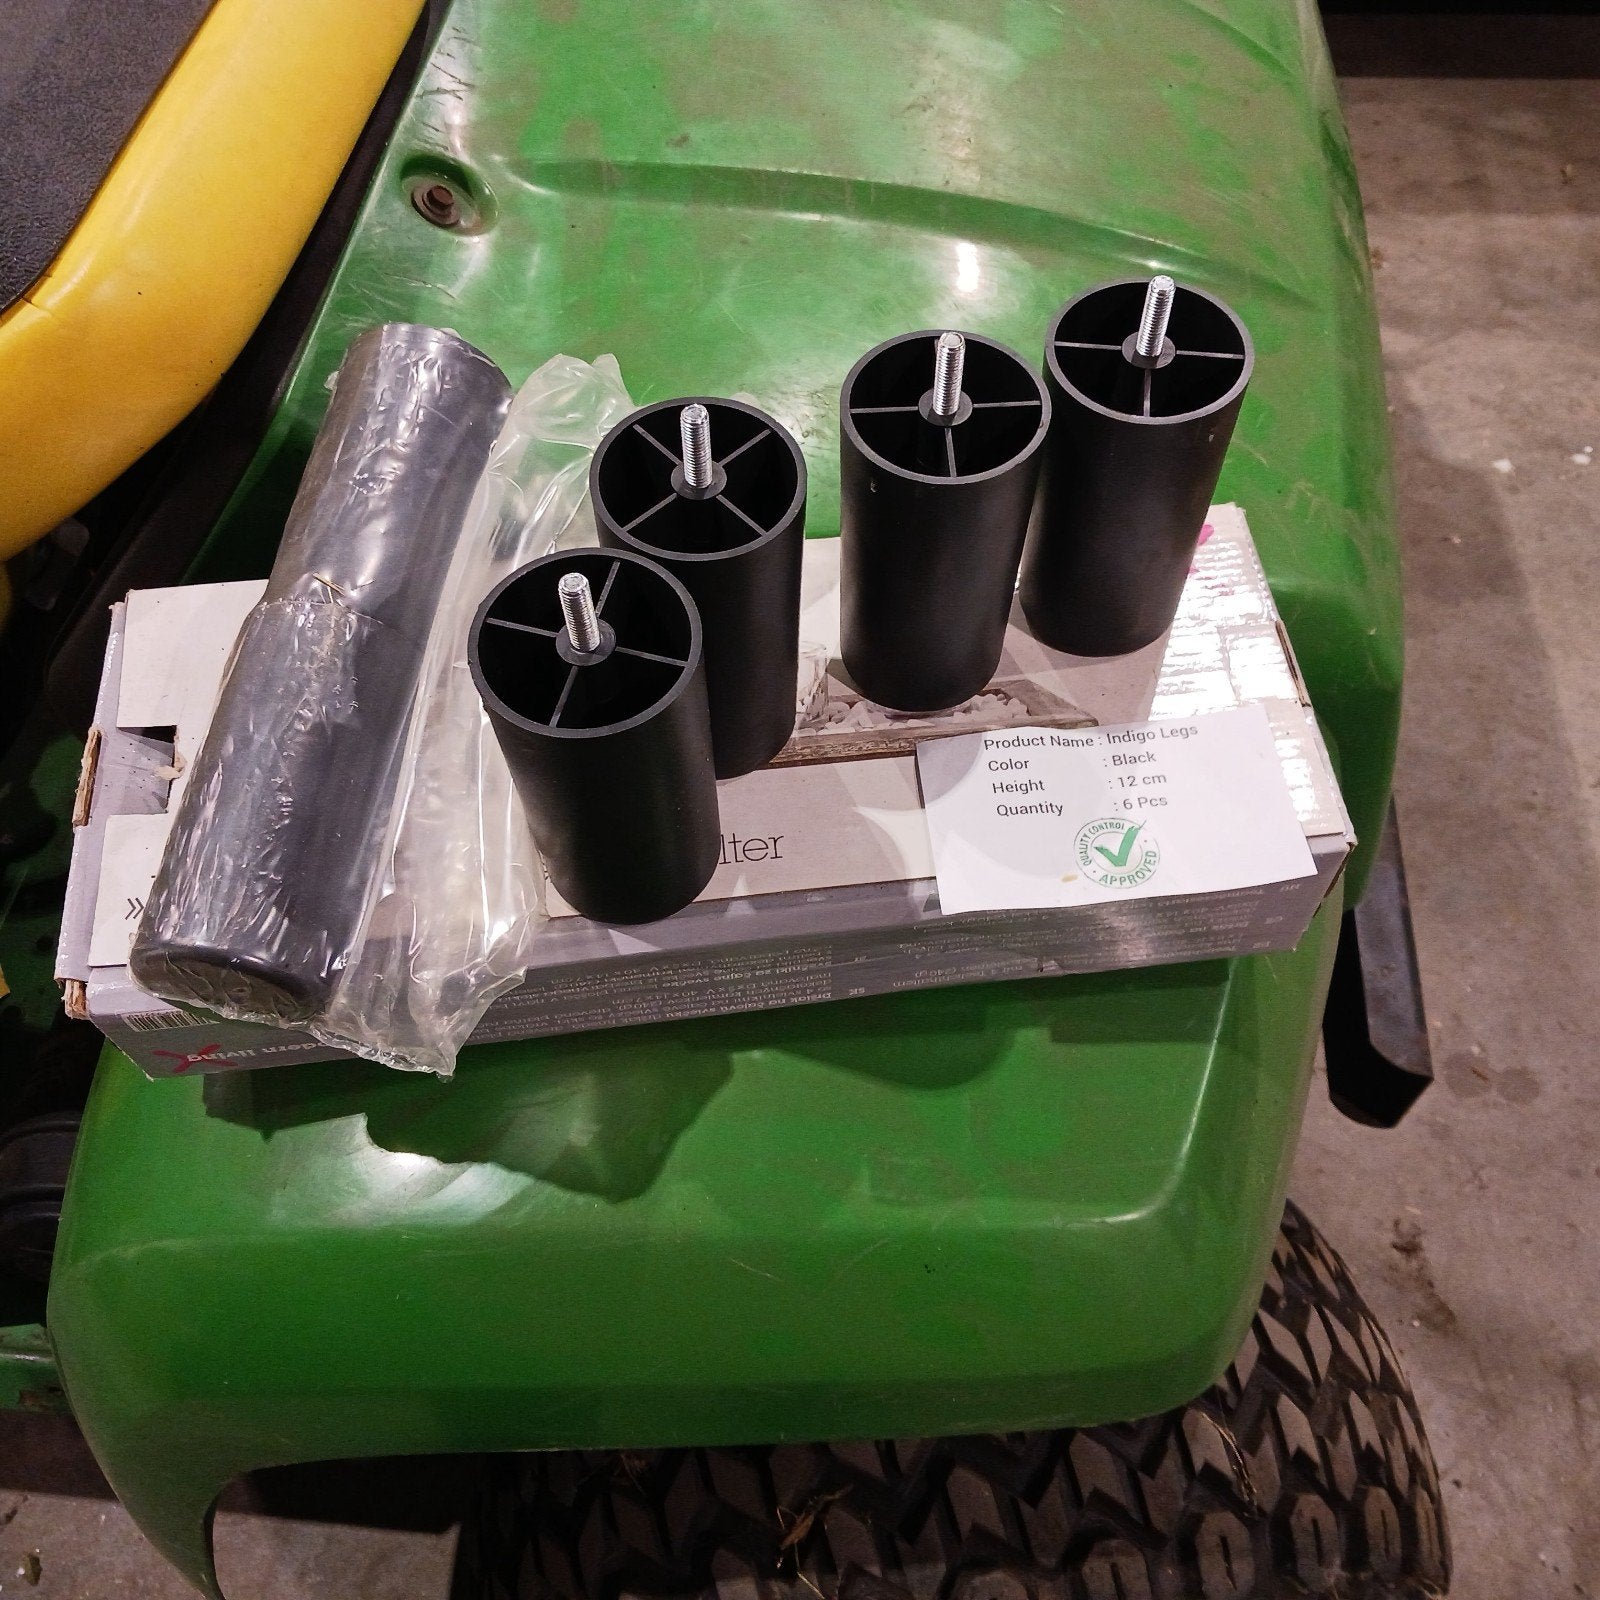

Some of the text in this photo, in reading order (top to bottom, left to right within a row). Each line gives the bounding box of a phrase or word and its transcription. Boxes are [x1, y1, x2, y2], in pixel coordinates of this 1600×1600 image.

[984, 735, 1046, 750] Product
[1050, 735, 1094, 748] Name
[1106, 730, 1156, 745] Indigo
[1160, 725, 1198, 739] Legs
[988, 758, 1030, 771] Color
[1112, 751, 1157, 766] Black
[992, 779, 1045, 794] Height
[1118, 775, 1137, 788] 12
[1142, 774, 1167, 785] cm
[996, 800, 1064, 816] Quantity
[1123, 799, 1133, 810] 6
[1137, 796, 1168, 808] Pcs
[719, 832, 784, 864] lter
[1079, 832, 1092, 866] QUALITY
[1099, 850, 1157, 886] APPROVED
